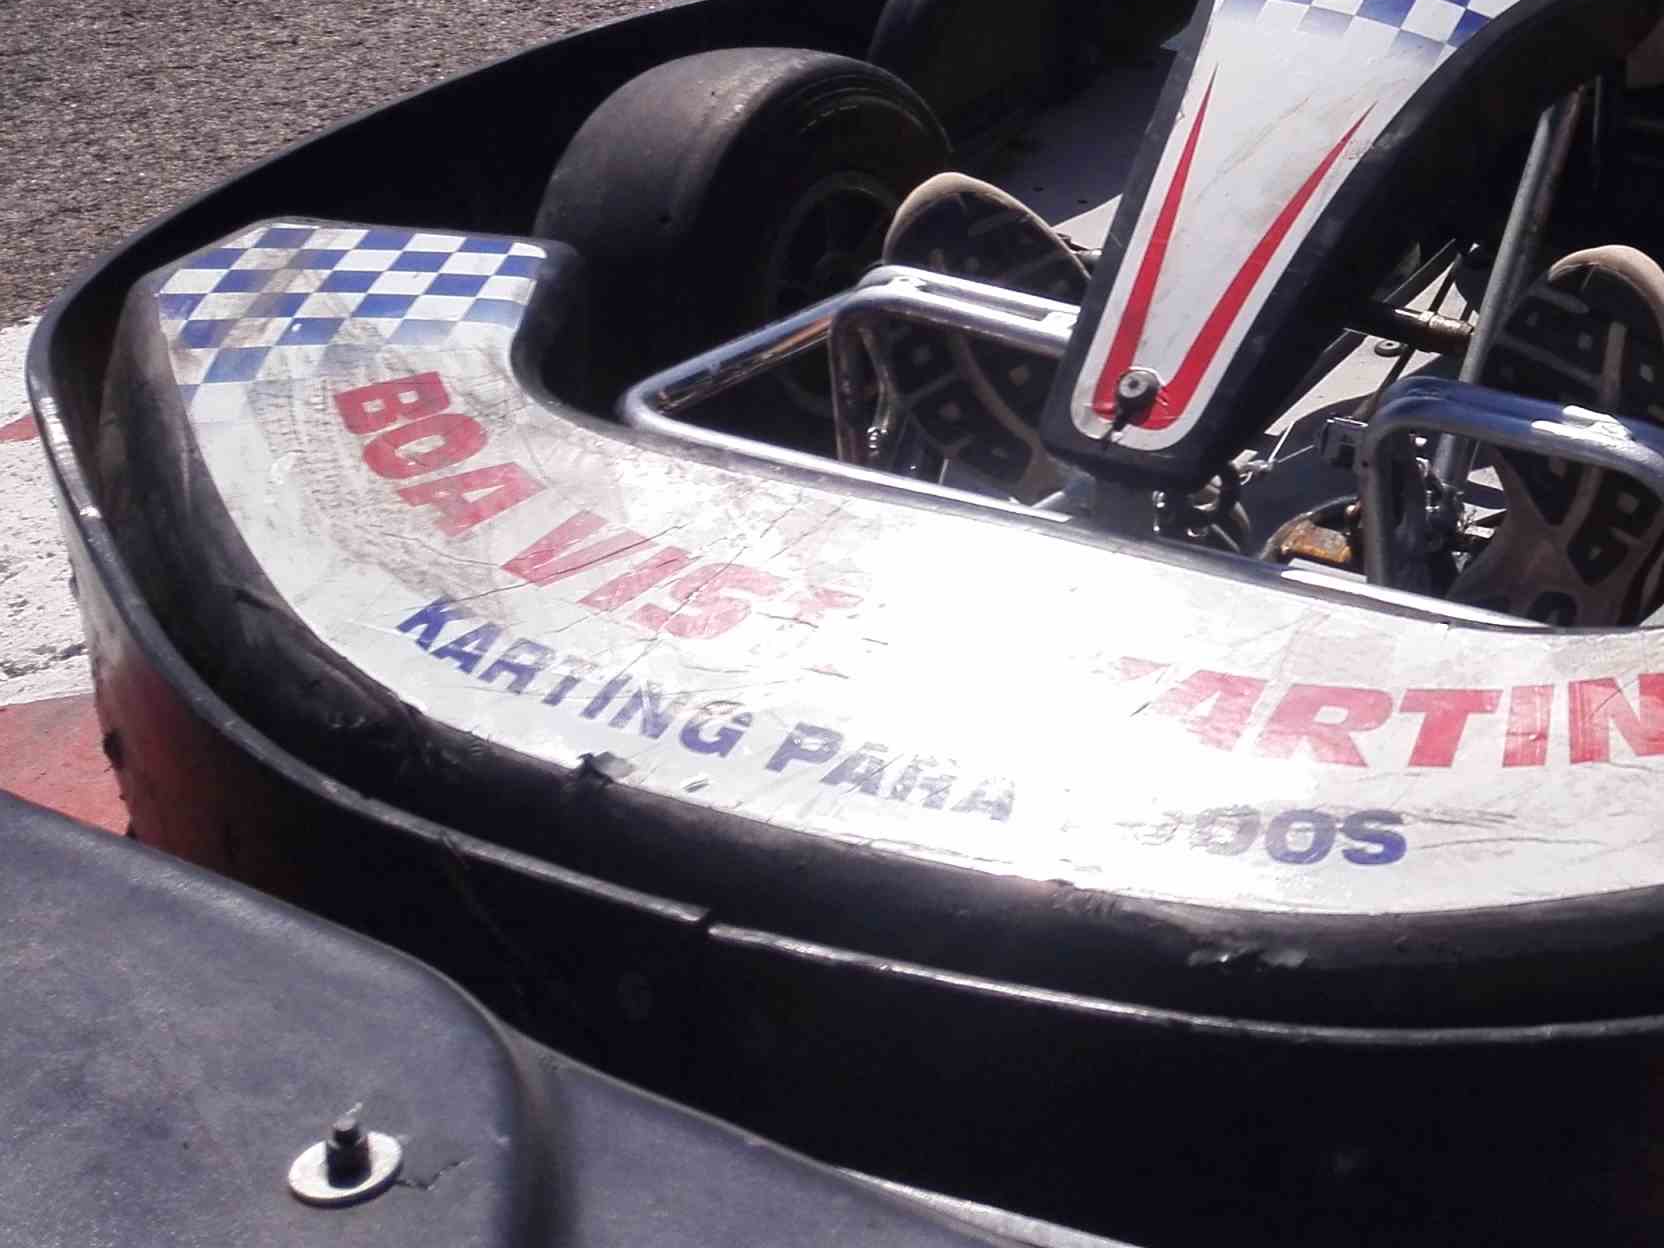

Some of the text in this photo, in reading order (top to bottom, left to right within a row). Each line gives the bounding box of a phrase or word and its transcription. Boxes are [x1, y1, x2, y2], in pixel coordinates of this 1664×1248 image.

[333, 370, 550, 537] BOA
[500, 509, 866, 642] VIS
[395, 598, 756, 758] KARTING
[1158, 802, 1408, 866] DOS
